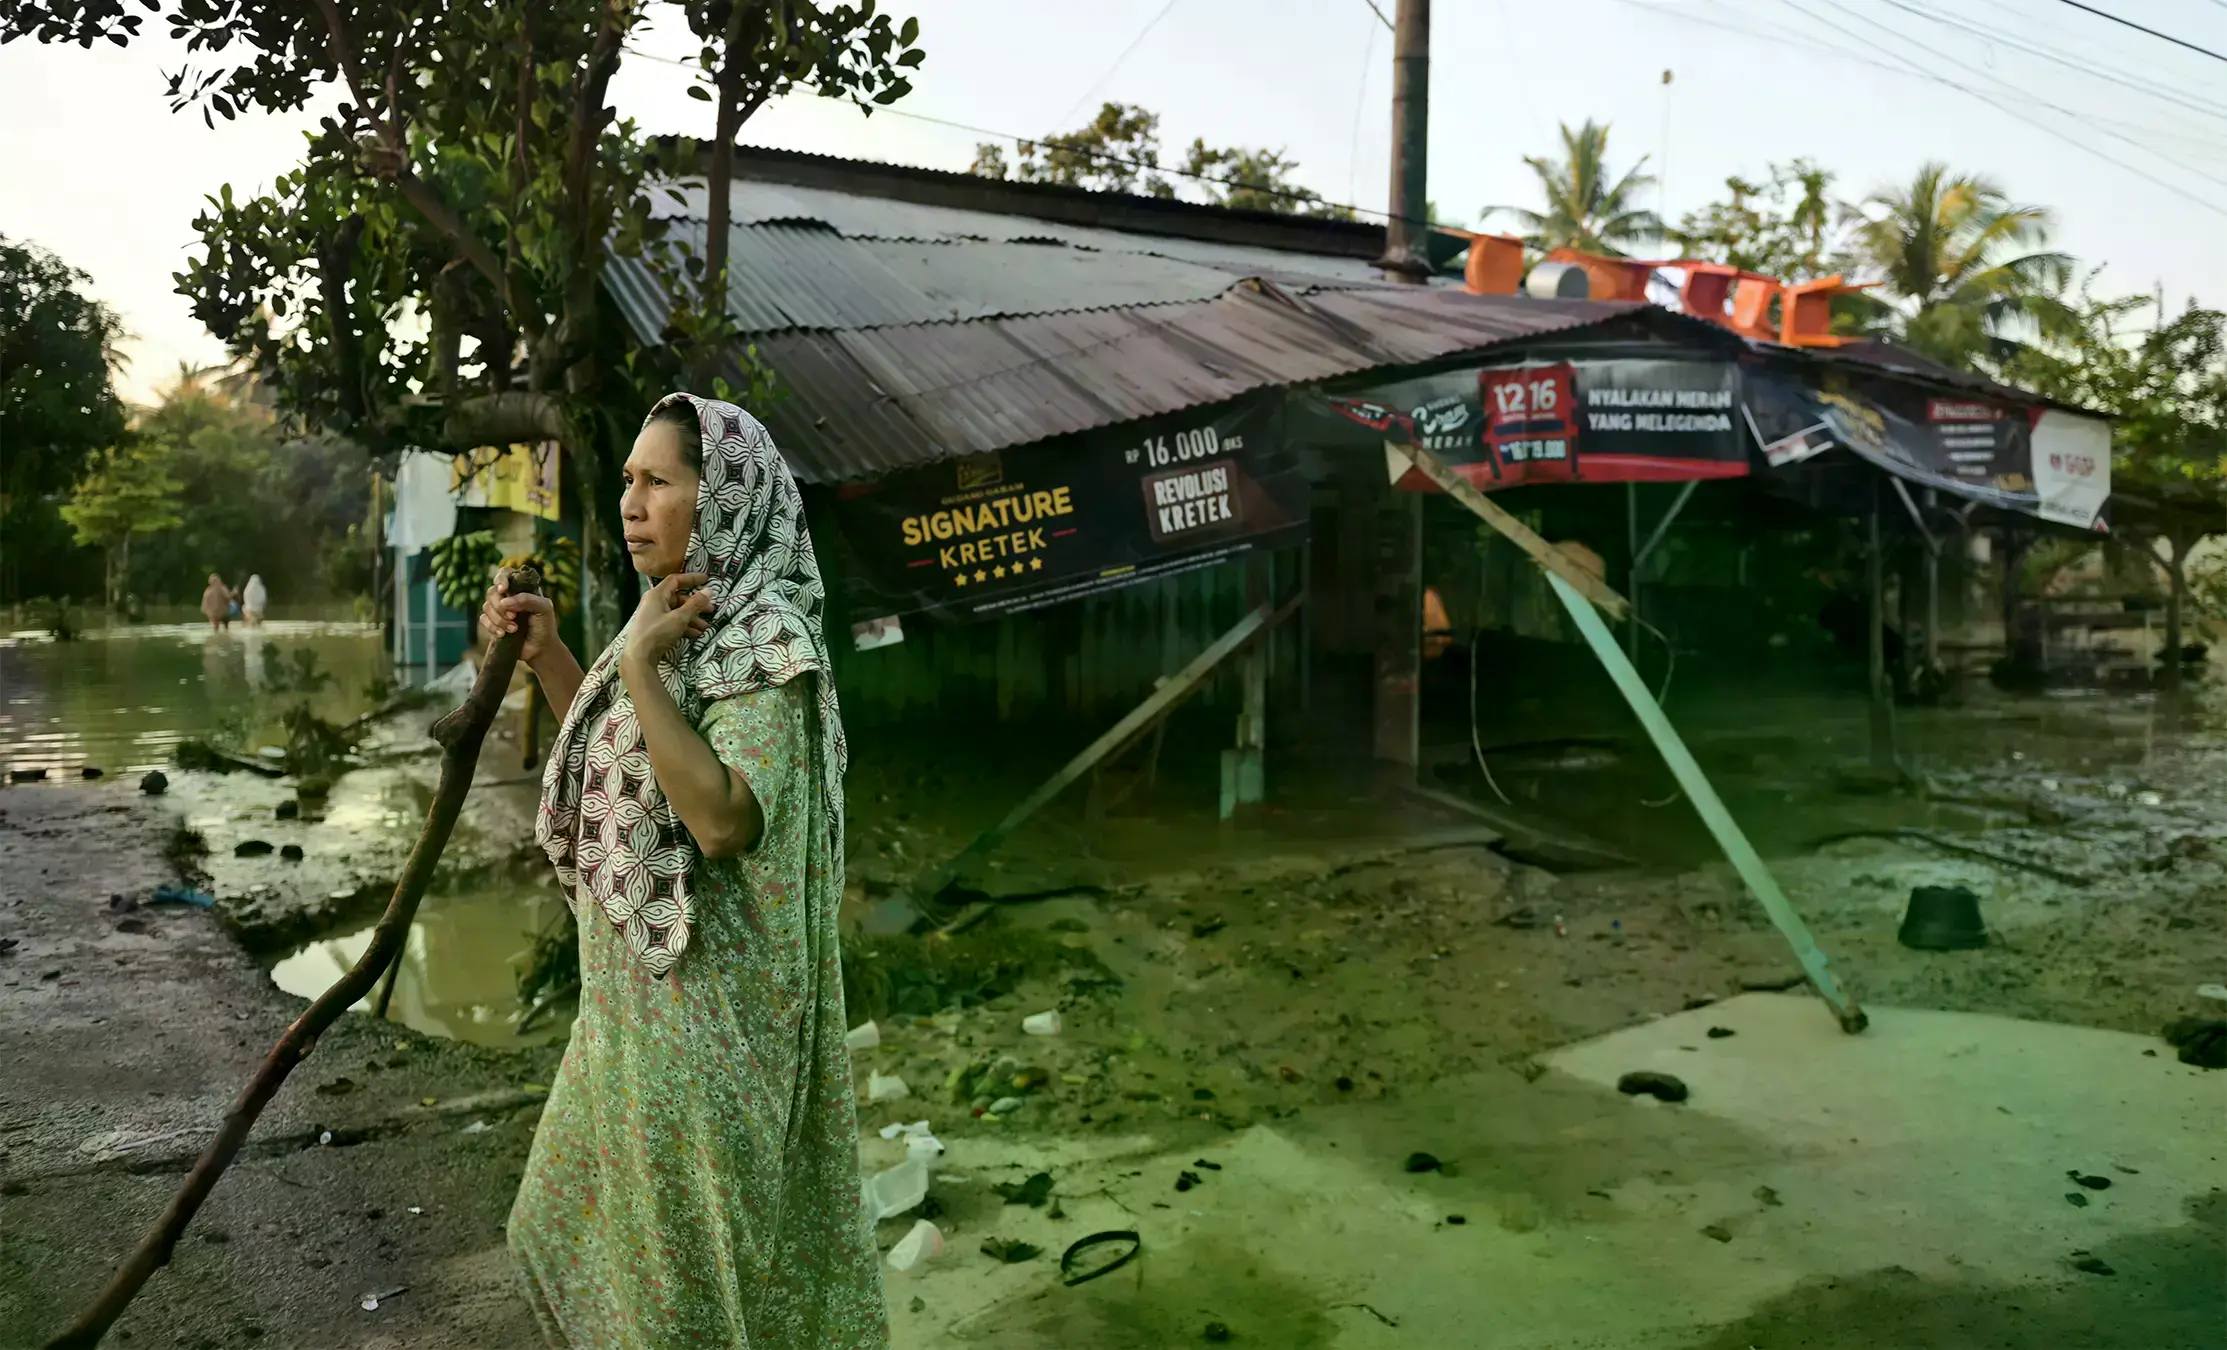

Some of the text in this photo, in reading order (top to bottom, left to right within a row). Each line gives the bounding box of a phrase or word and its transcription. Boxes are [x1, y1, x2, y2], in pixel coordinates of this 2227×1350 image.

[1494, 382, 1526, 413] 12
[1528, 379, 1557, 411] 16
[1588, 413, 1633, 431] YANG
[1143, 426, 1220, 468] 16.000
[1153, 467, 1229, 506] REVOLUSI
[901, 486, 1074, 546] SIGNATURE
[1158, 493, 1233, 534] KRETEK
[939, 527, 1048, 569] KRETEK
